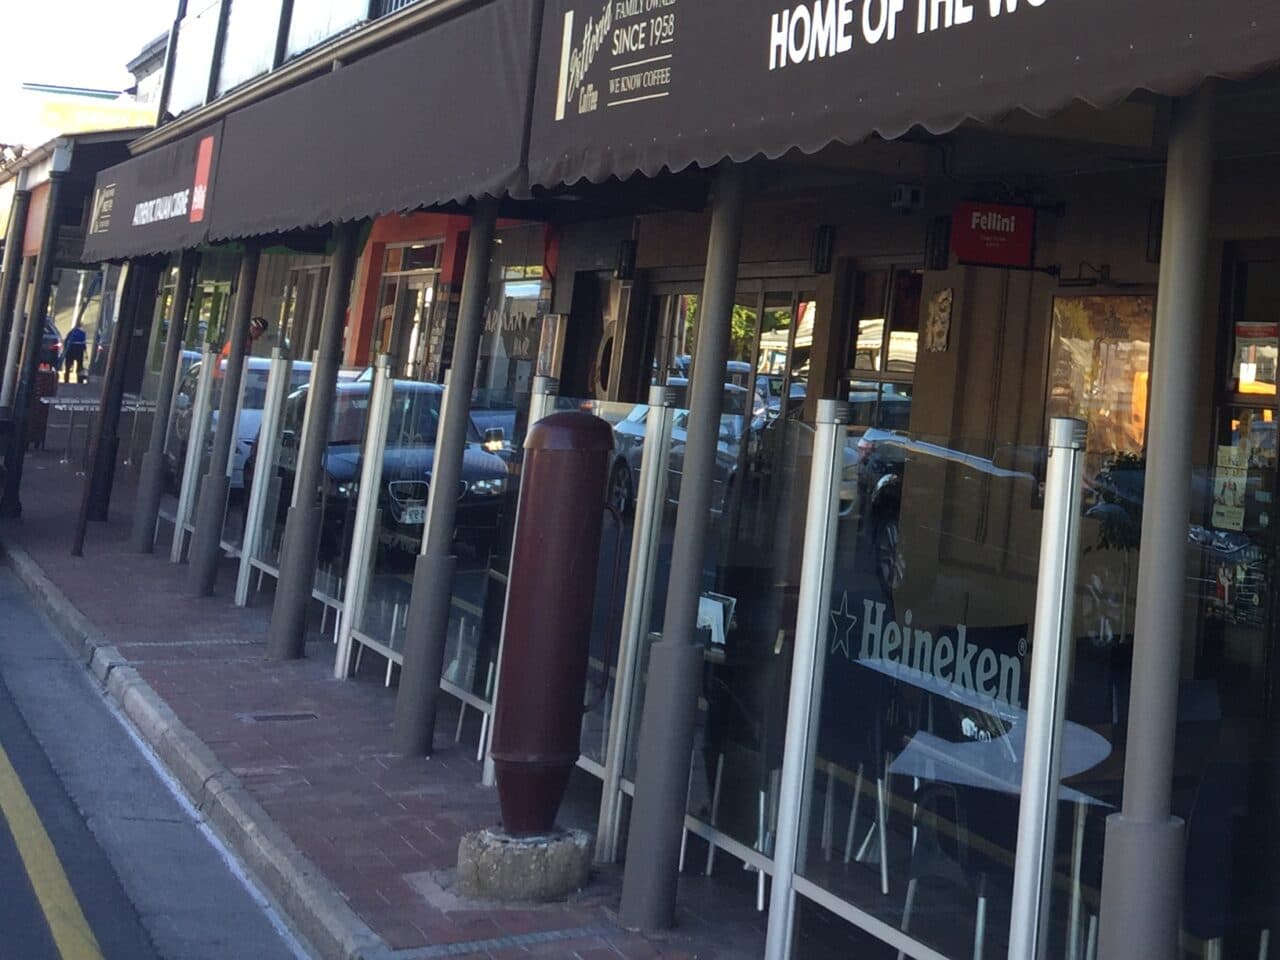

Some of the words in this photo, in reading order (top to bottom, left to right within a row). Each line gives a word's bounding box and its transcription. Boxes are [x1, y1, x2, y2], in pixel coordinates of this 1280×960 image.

[611, 22, 647, 56] SINCE
[649, 14, 675, 46] 1958
[608, 78, 620, 94] WE
[620, 71, 644, 92] KNOW
[643, 67, 672, 88] COFFEE
[970, 211, 1016, 233] Fellini
